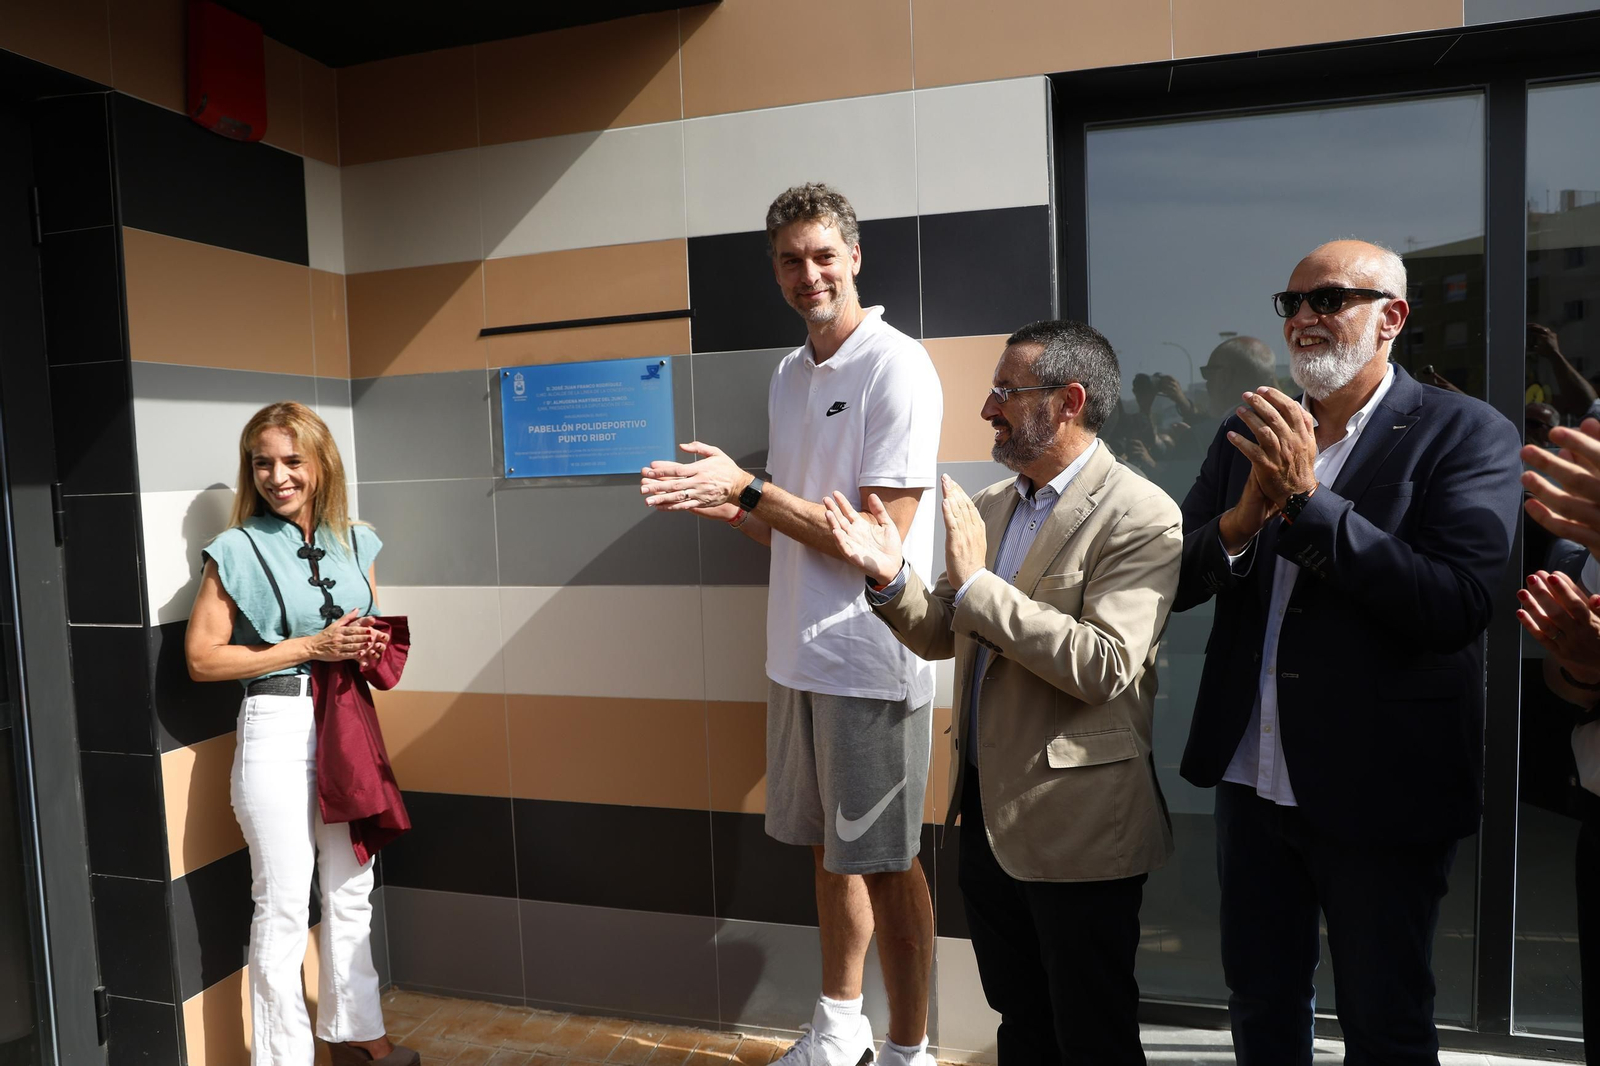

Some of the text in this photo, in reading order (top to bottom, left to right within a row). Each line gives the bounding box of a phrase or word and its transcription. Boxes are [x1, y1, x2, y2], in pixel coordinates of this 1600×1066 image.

[528, 420, 647, 433] PABELLÓN POLIDEPORTIVO
[558, 433, 617, 443] PUNTO RIBOT
